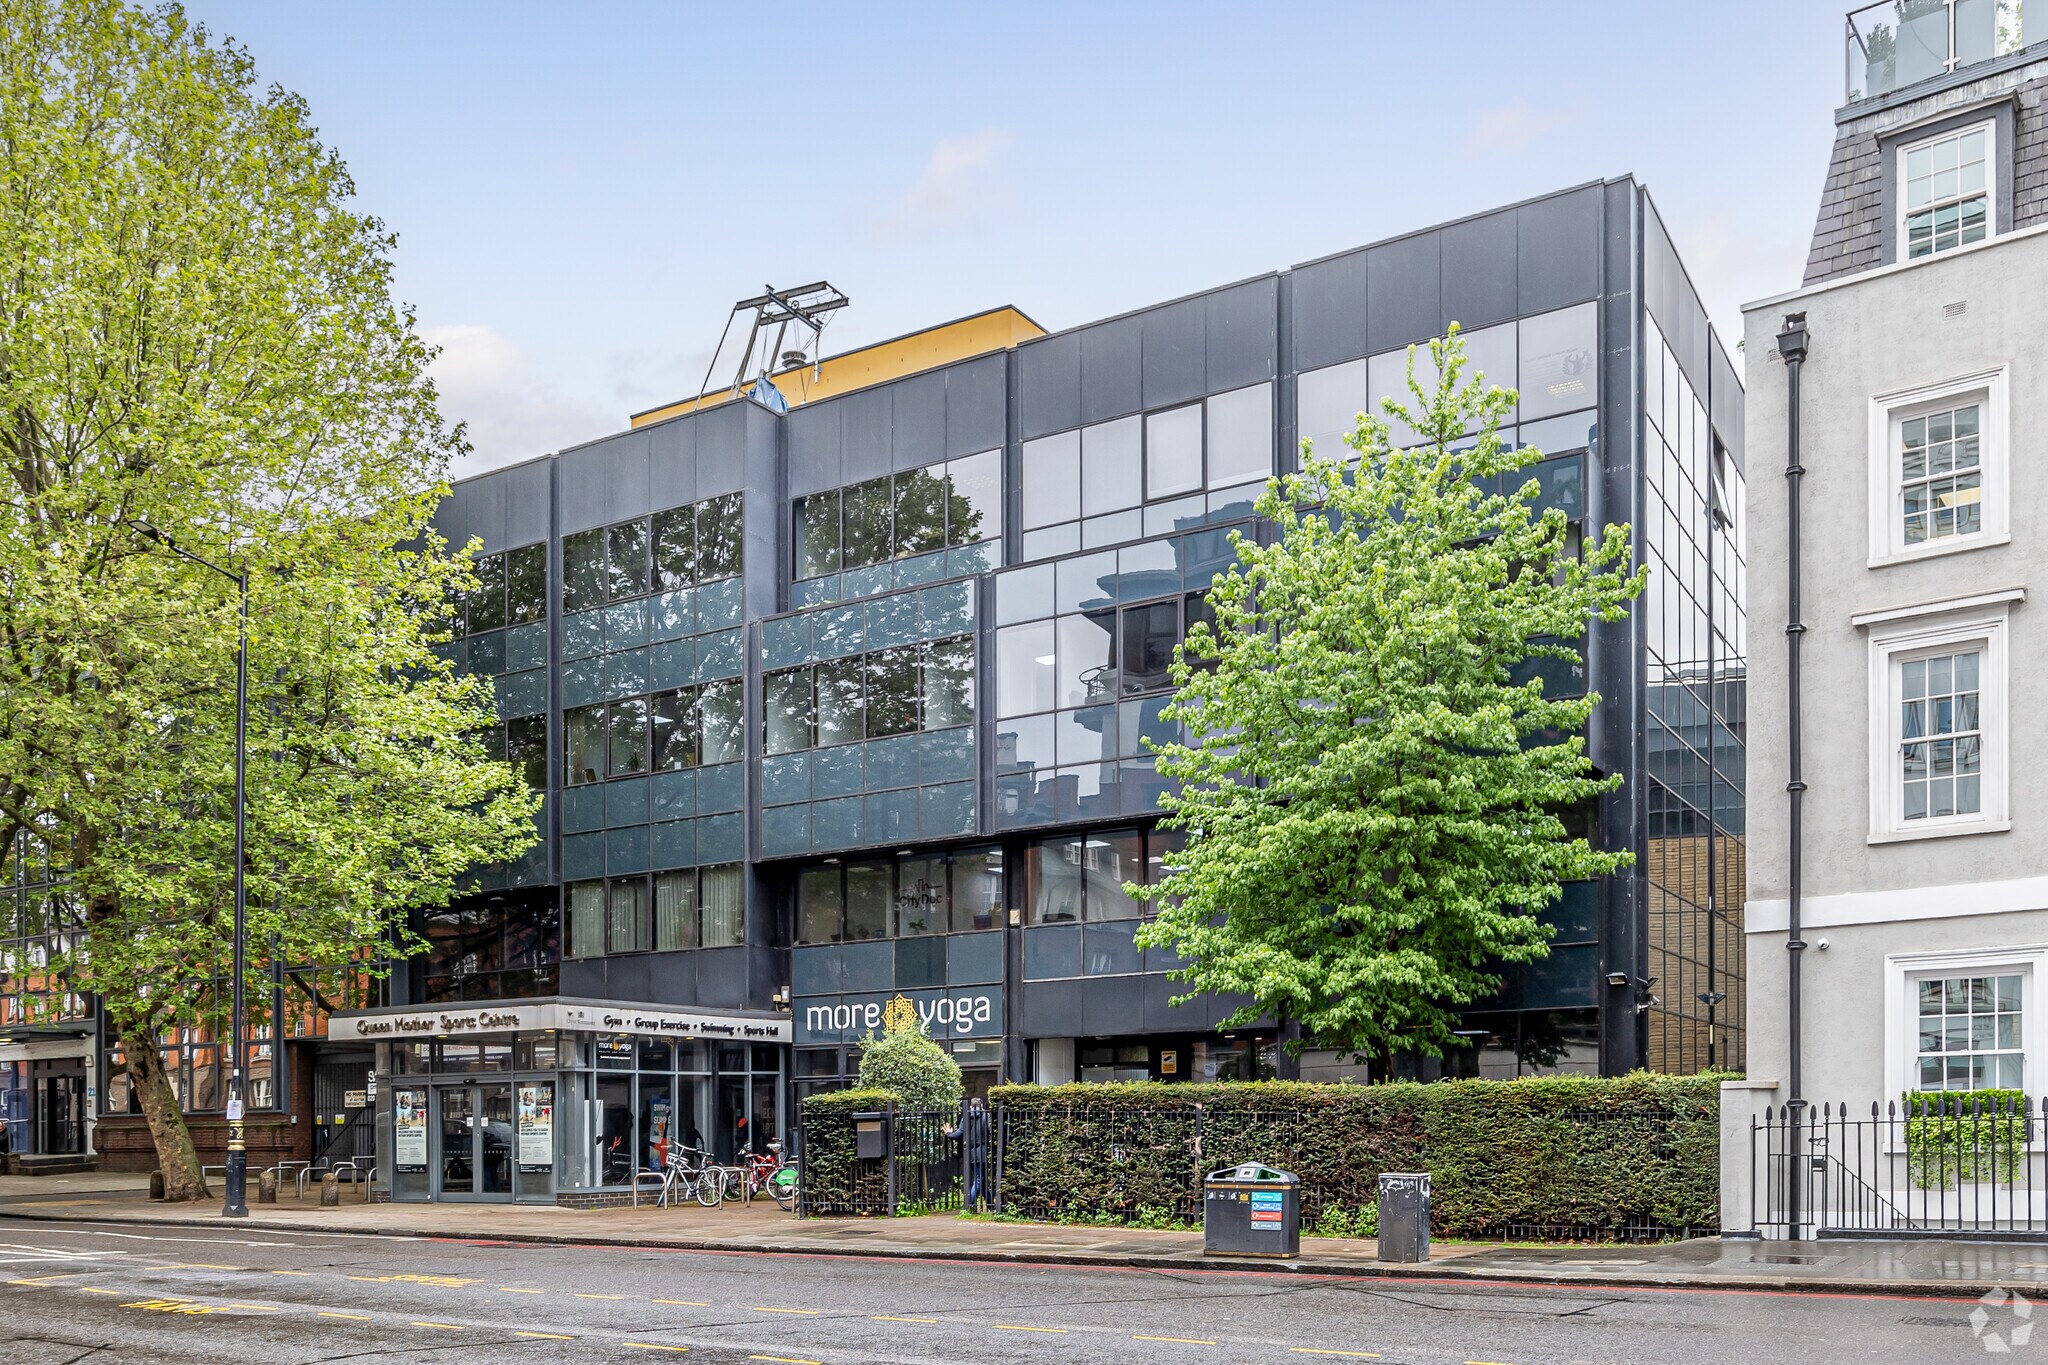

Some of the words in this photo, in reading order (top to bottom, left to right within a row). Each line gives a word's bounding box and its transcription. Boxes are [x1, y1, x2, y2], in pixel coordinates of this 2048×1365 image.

[900, 894, 942, 908] CityDoc
[356, 1019, 392, 1035] Queen
[394, 1017, 435, 1032] Mother
[440, 1014, 476, 1033] Sports
[479, 1011, 519, 1027] Centre
[604, 1015, 622, 1028] Gym
[635, 1017, 659, 1031] Group
[660, 1019, 690, 1031] Exercise
[701, 1022, 734, 1036] Swimming
[744, 1025, 764, 1036] Sports
[766, 1026, 779, 1035] Hall
[807, 1003, 880, 1031] more
[918, 996, 990, 1035] yoga
[618, 1043, 632, 1051] yoga
